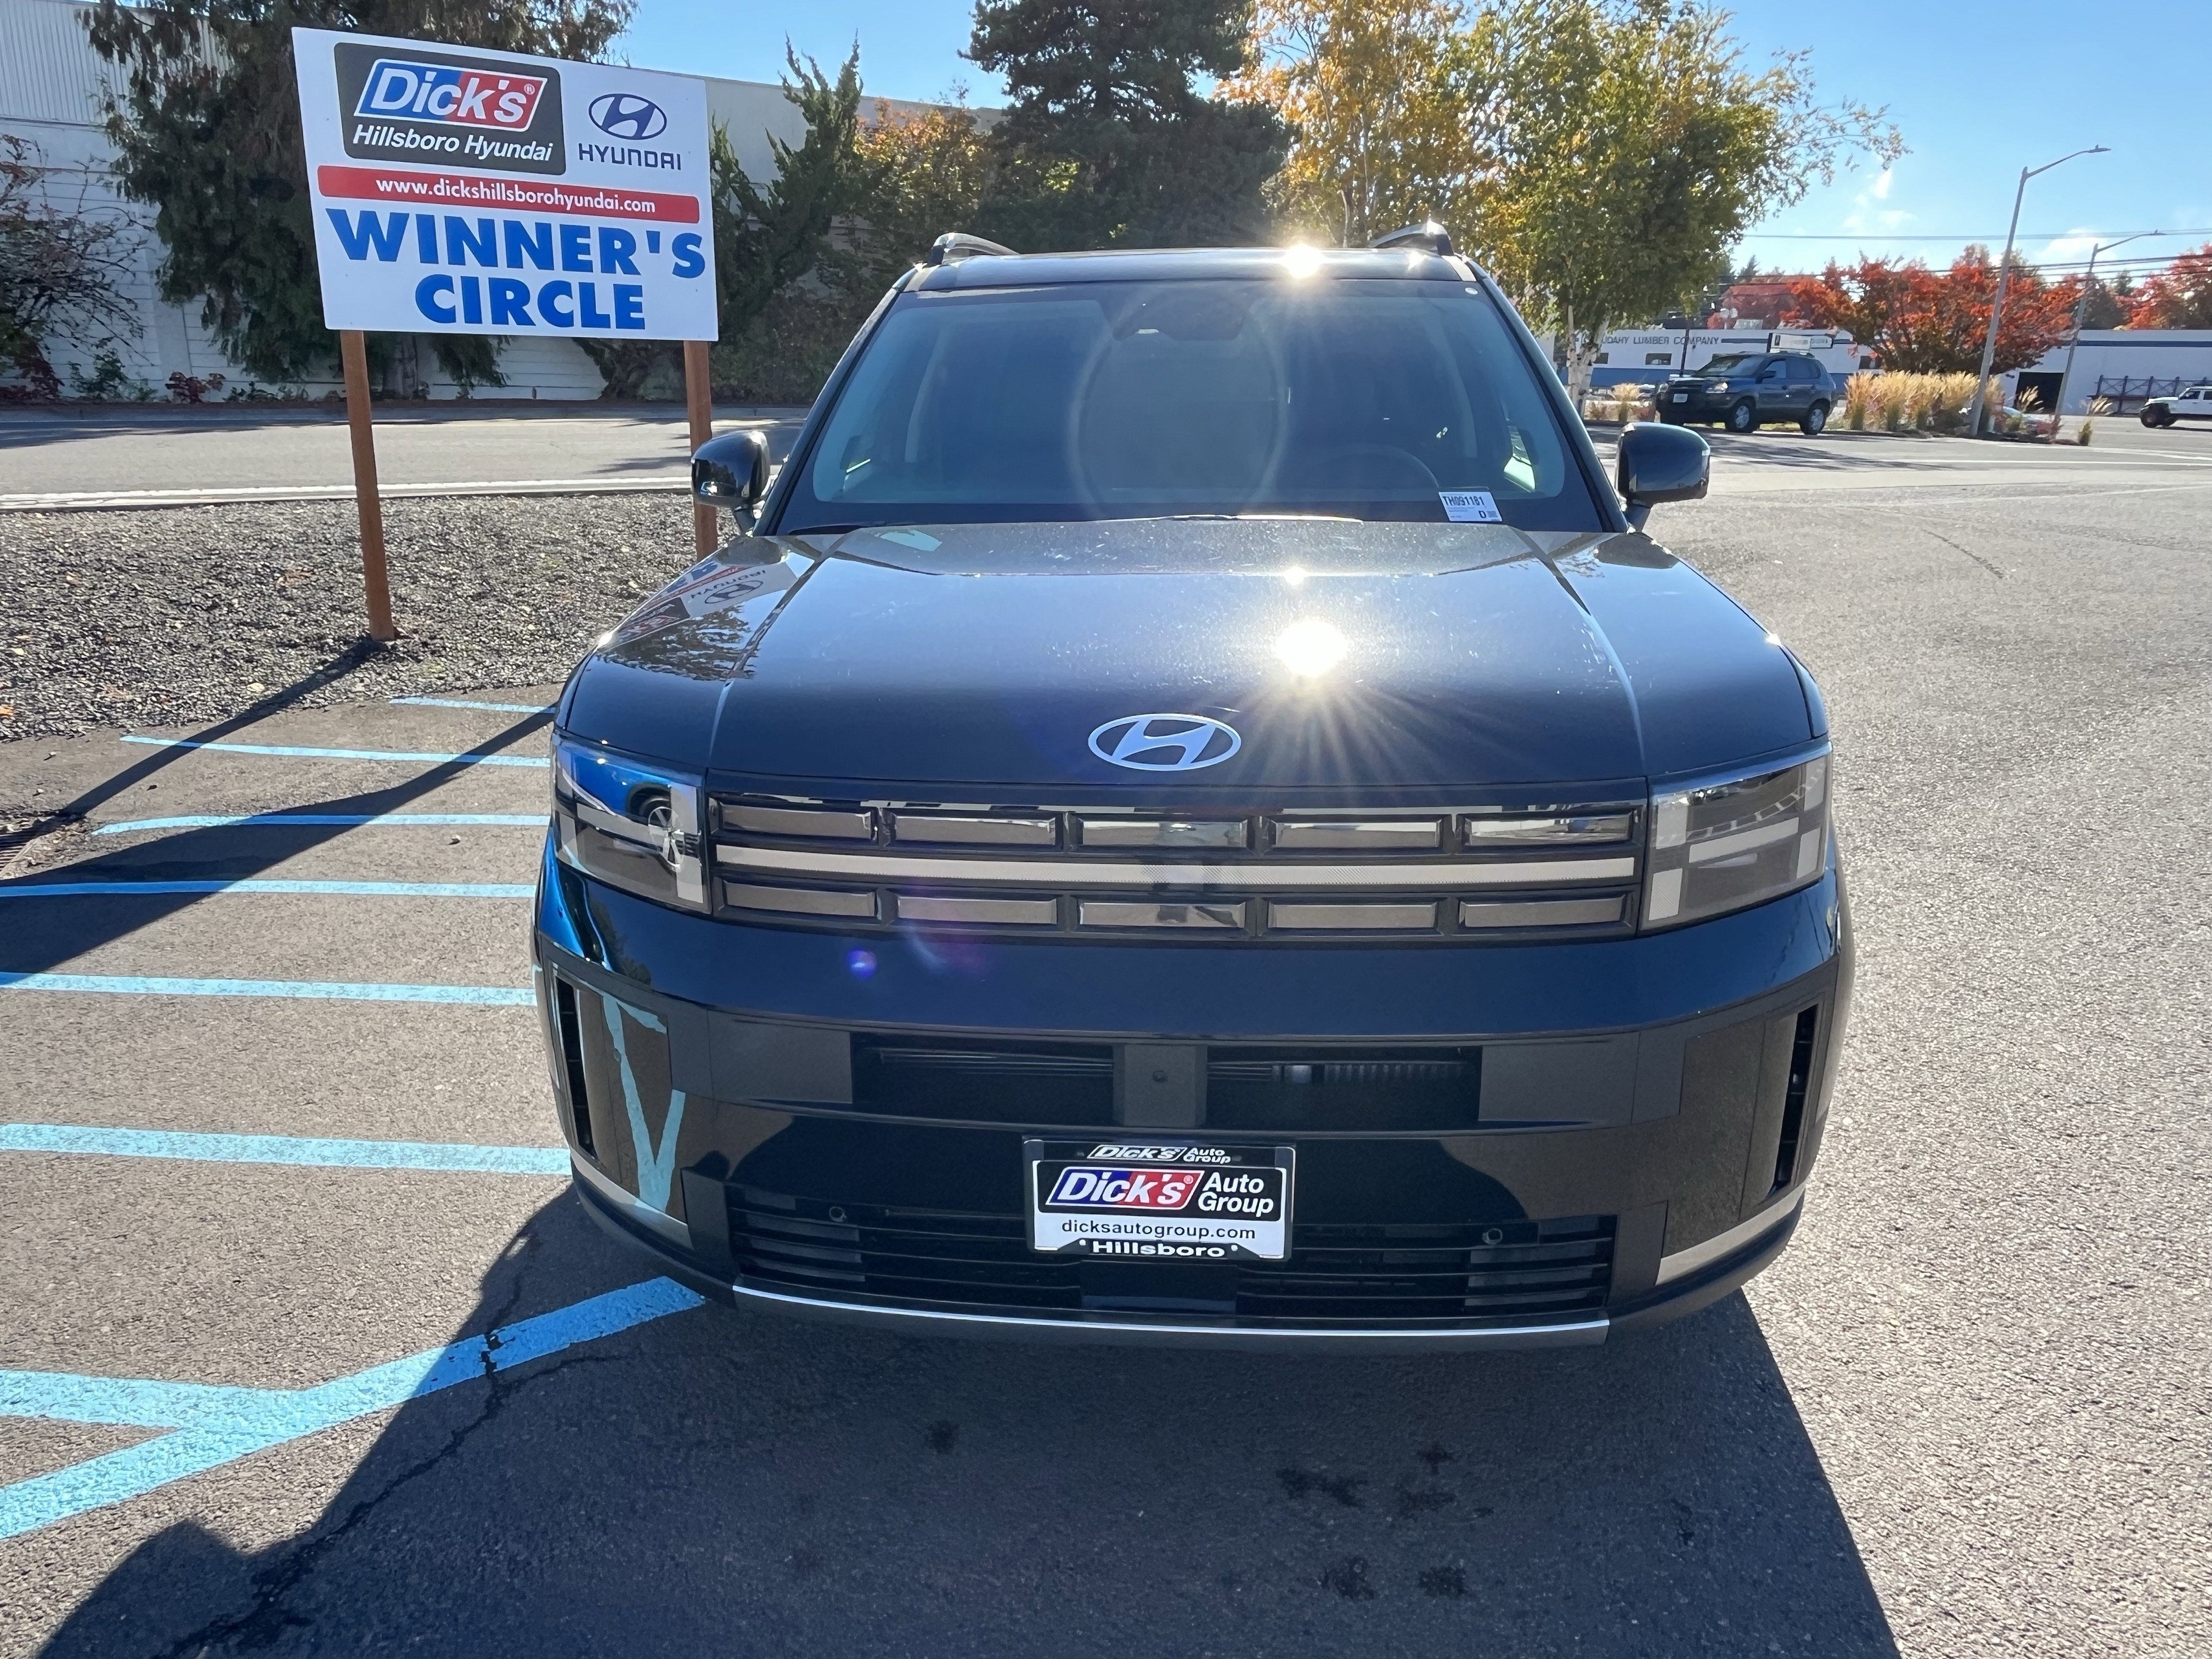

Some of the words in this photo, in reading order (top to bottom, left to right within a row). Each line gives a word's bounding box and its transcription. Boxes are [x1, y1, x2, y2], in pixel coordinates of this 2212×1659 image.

[371, 70, 528, 123] Dick's
[353, 124, 460, 152] Hillsboro
[464, 134, 554, 161] Hyundai
[579, 143, 681, 171] HYUNDAI
[376, 178, 656, 213] www.dickshillsborohyundai.com
[325, 208, 706, 279] WINNER'S
[415, 274, 645, 330] CIRCLE
[1633, 336, 1669, 345] LUMBER
[1183, 1154, 1231, 1164] Group
[1187, 1147, 1225, 1156] Auto
[1202, 1172, 1264, 1194] Auto
[1198, 1191, 1274, 1217] Group
[1062, 1219, 1256, 1239] dicksautogroup.com
[1092, 1240, 1226, 1258] Hillsboro
